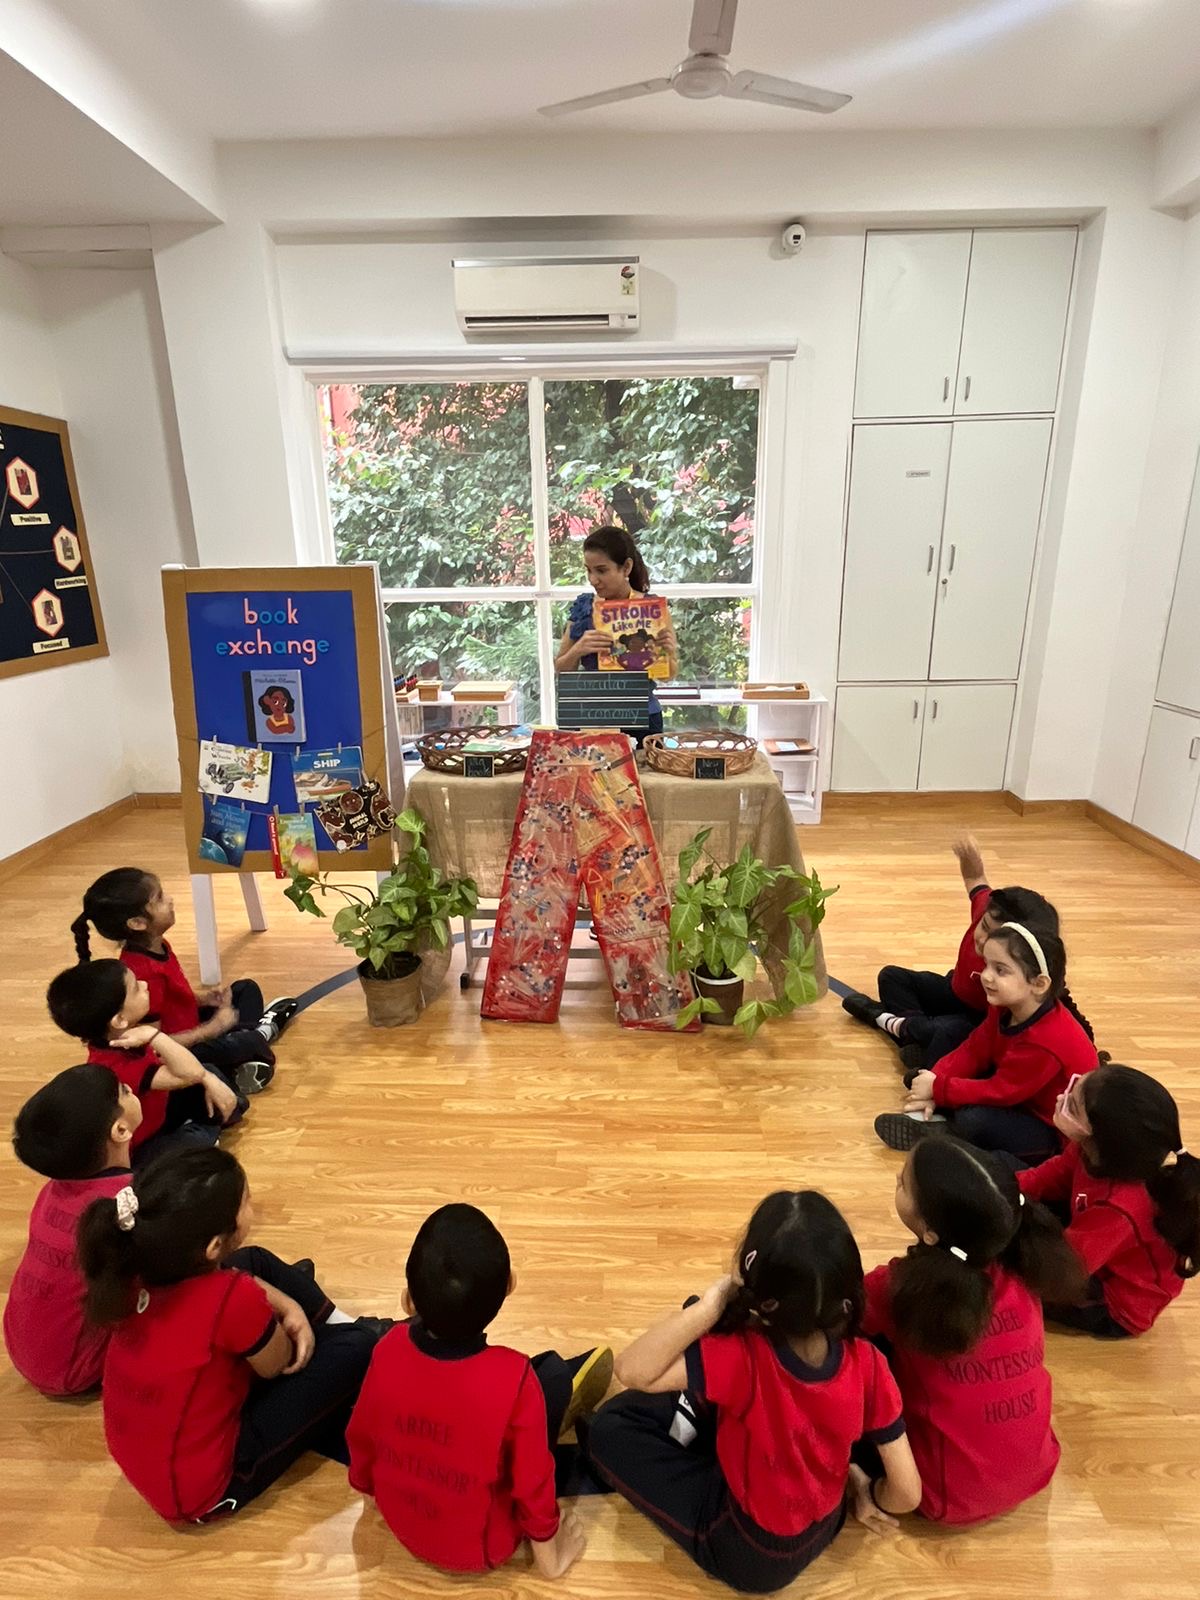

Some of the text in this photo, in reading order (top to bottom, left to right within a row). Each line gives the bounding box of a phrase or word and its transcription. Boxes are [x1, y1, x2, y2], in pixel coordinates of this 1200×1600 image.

[243, 597, 299, 624] book
[601, 603, 662, 624] STRONG
[215, 628, 330, 665] exchange
[313, 758, 341, 769] SHIP
[984, 1389, 1037, 1424] HOUSE
